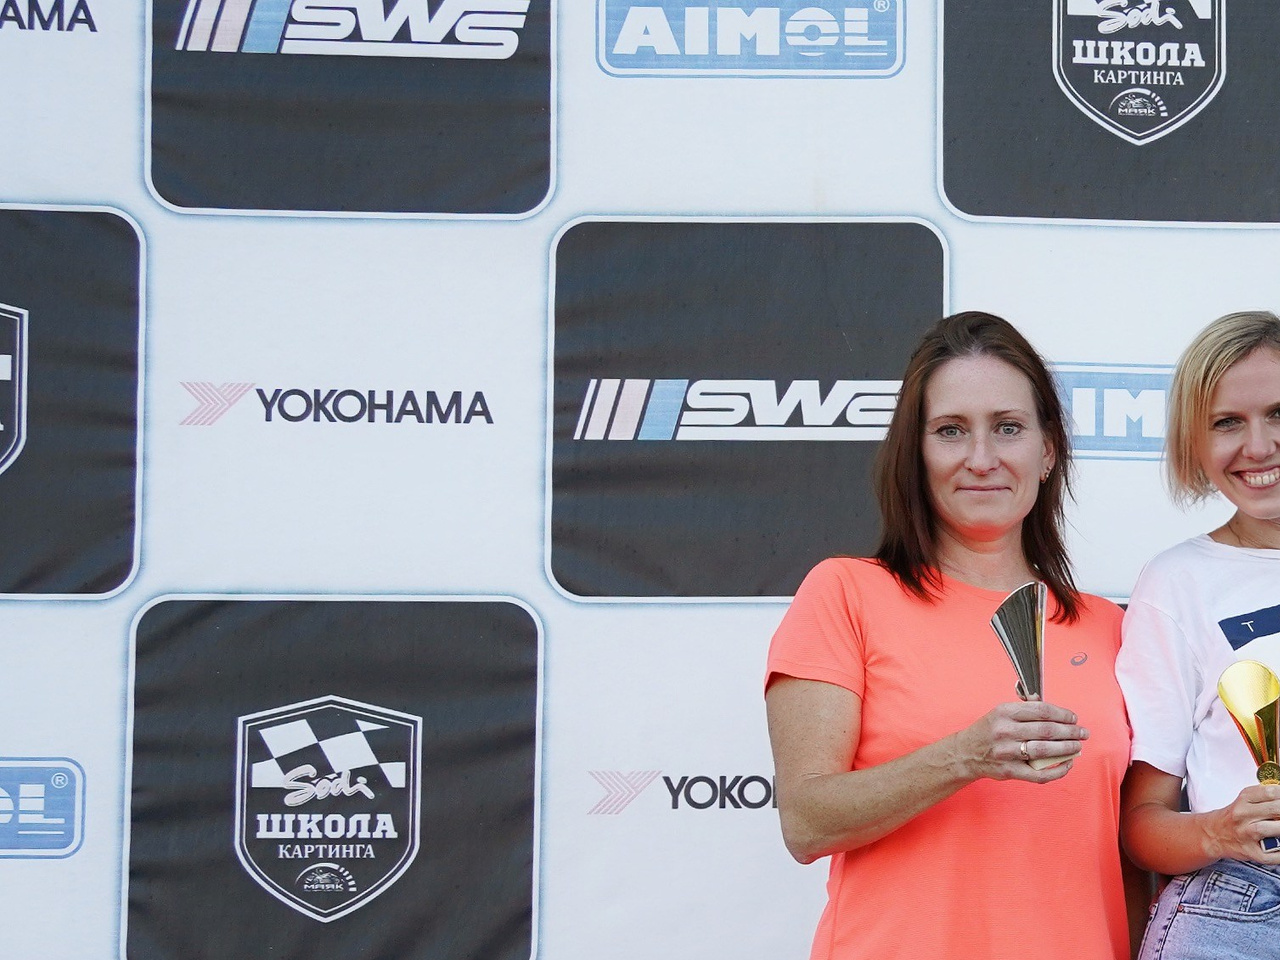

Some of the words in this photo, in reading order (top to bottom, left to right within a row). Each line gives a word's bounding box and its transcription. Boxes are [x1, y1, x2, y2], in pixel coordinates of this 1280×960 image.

[280, 0, 530, 59] SWS
[1072, 40, 1206, 67] ШКОЛА
[1093, 70, 1185, 85] КАРТИНГА
[255, 388, 494, 425] YOKOHAMA
[284, 764, 375, 807] Sodi
[662, 775, 778, 809] YOKO
[256, 813, 398, 839] ШКОЛА
[278, 844, 375, 859] КАРТИНГА
